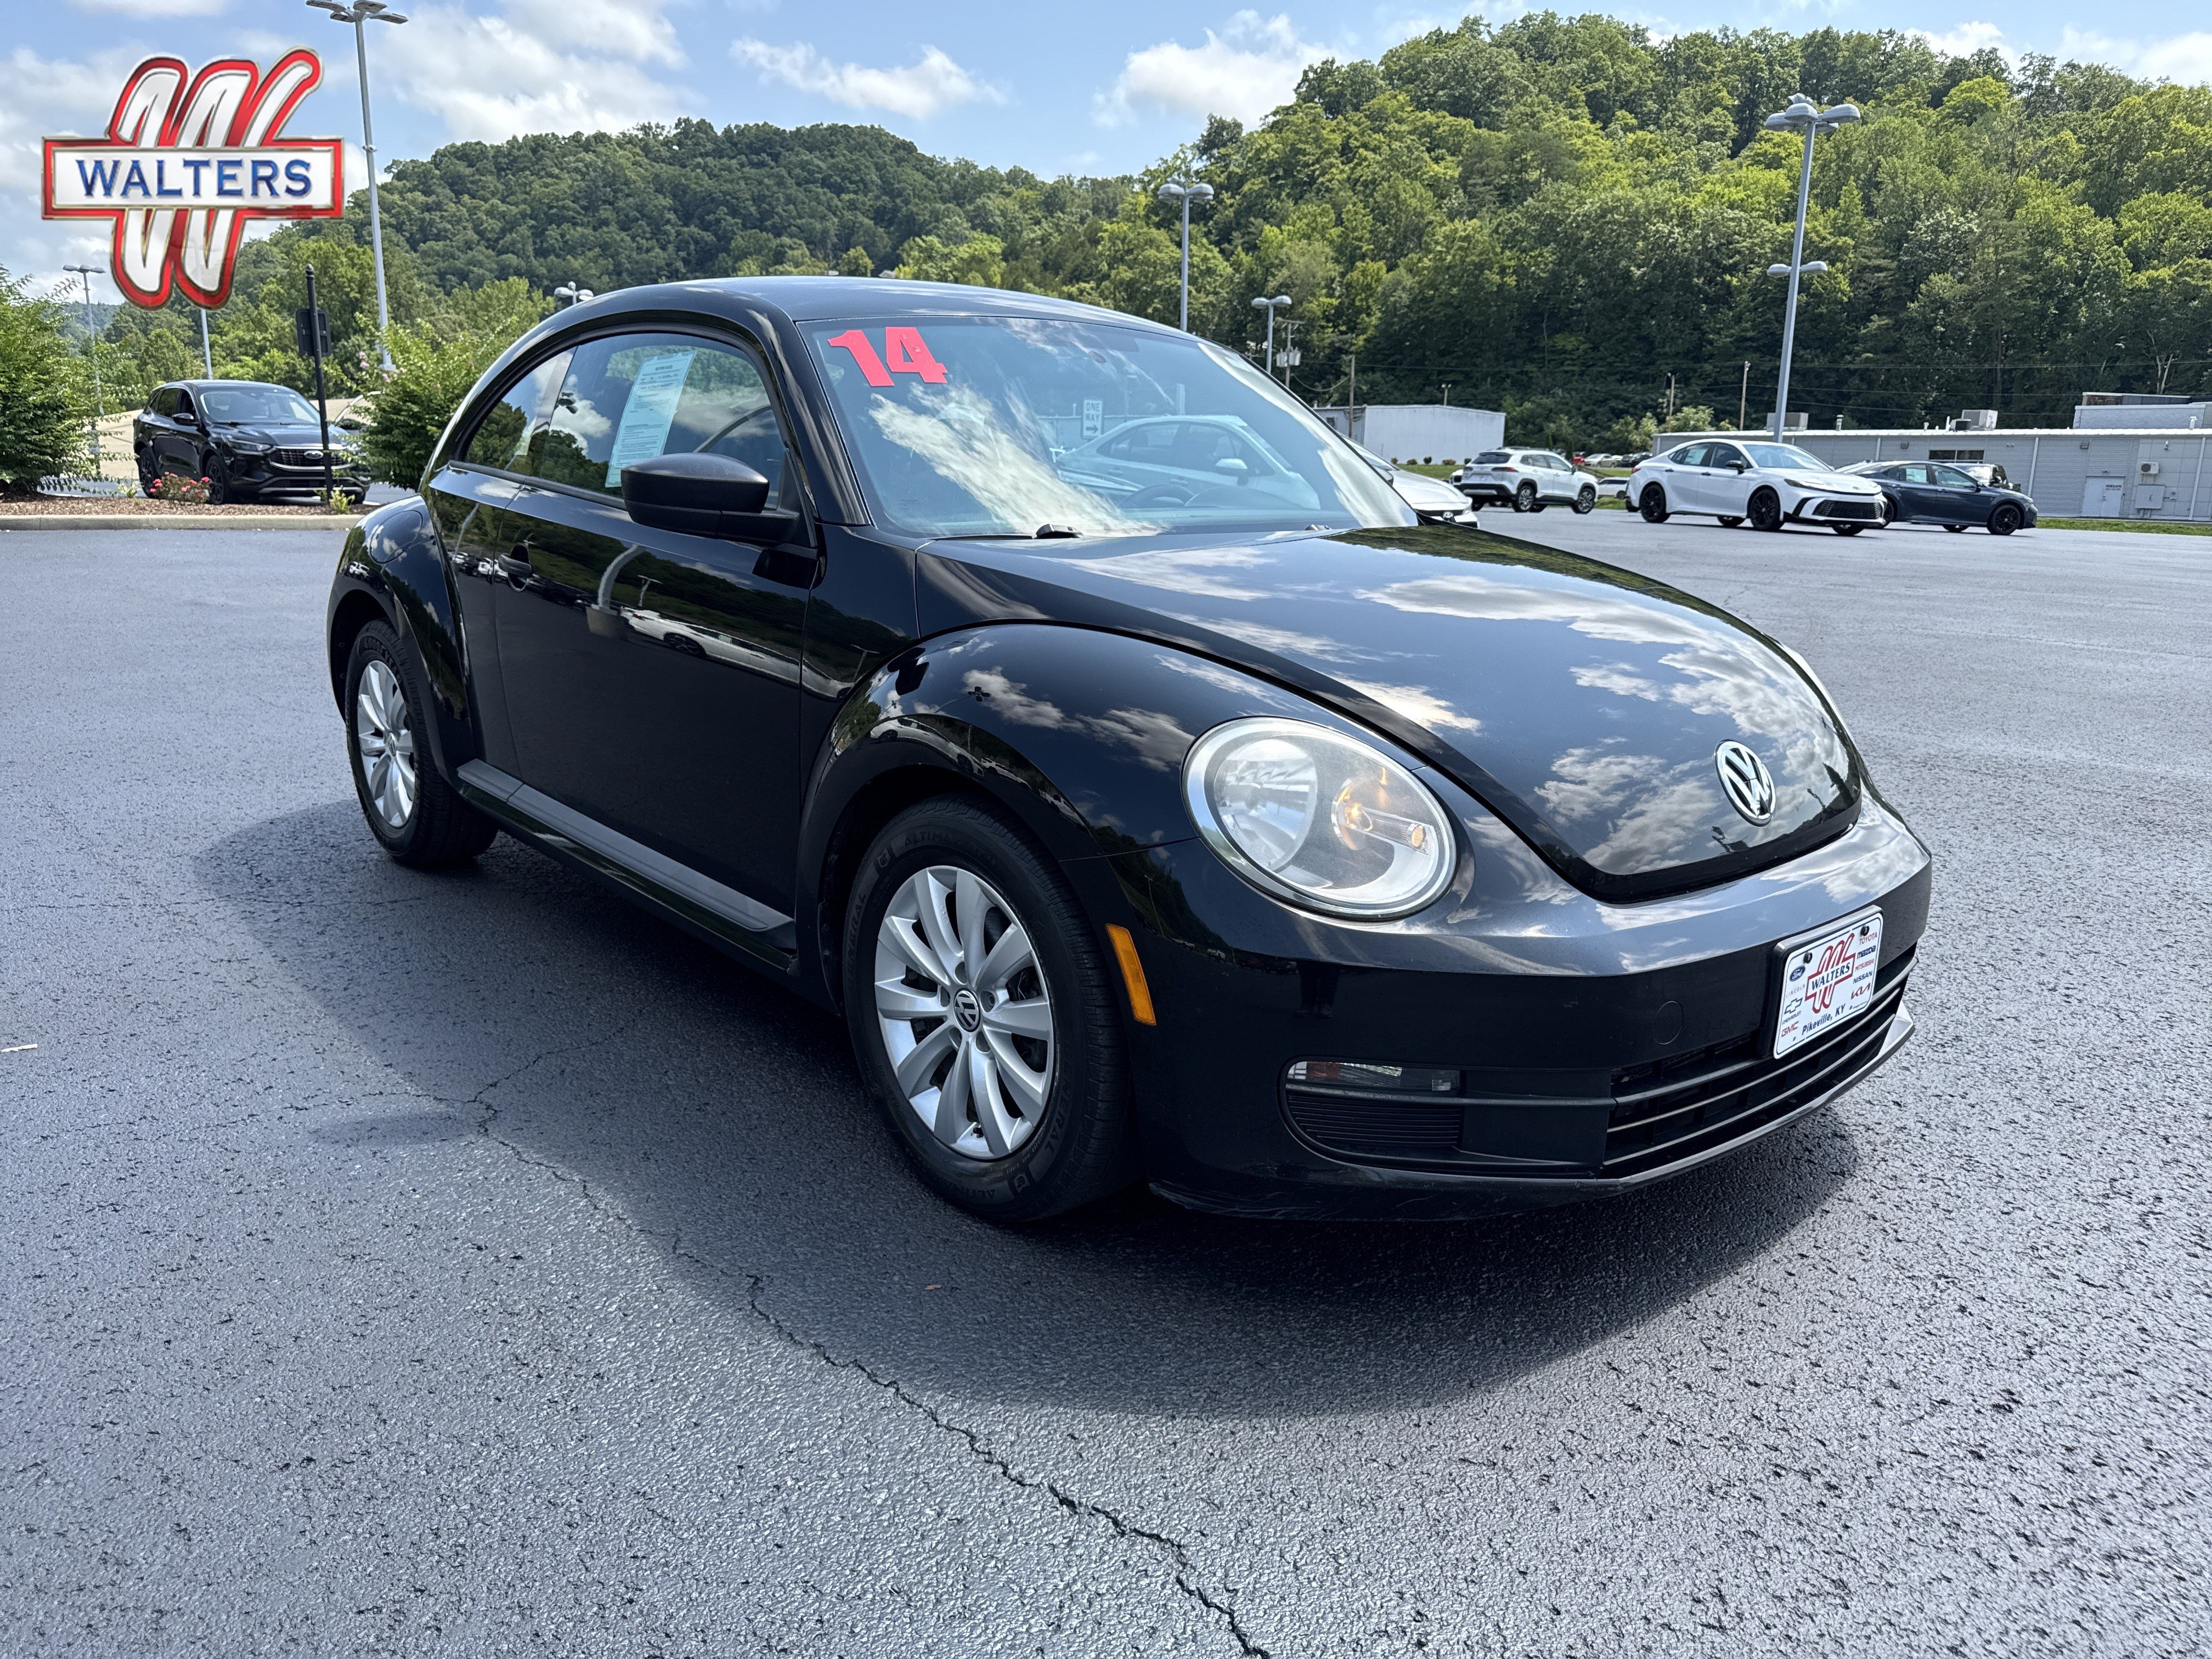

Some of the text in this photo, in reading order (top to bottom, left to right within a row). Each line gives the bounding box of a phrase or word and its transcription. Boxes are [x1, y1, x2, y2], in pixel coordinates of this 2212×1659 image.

[827, 326, 948, 387] 14
[1086, 402, 1100, 412] ONE
[1085, 413, 1100, 422] WAY
[1859, 932, 1877, 945] TOYOTA
[1812, 962, 1850, 991] WALTERS
[1853, 970, 1873, 985] NISSAN
[1786, 984, 1805, 997] LINCOLN
[1782, 1011, 1802, 1025] CHEVROLET
[1802, 1013, 1833, 1036] Pikeville,
[1835, 1003, 1846, 1017] KY
[1781, 1021, 1799, 1037] GMC
